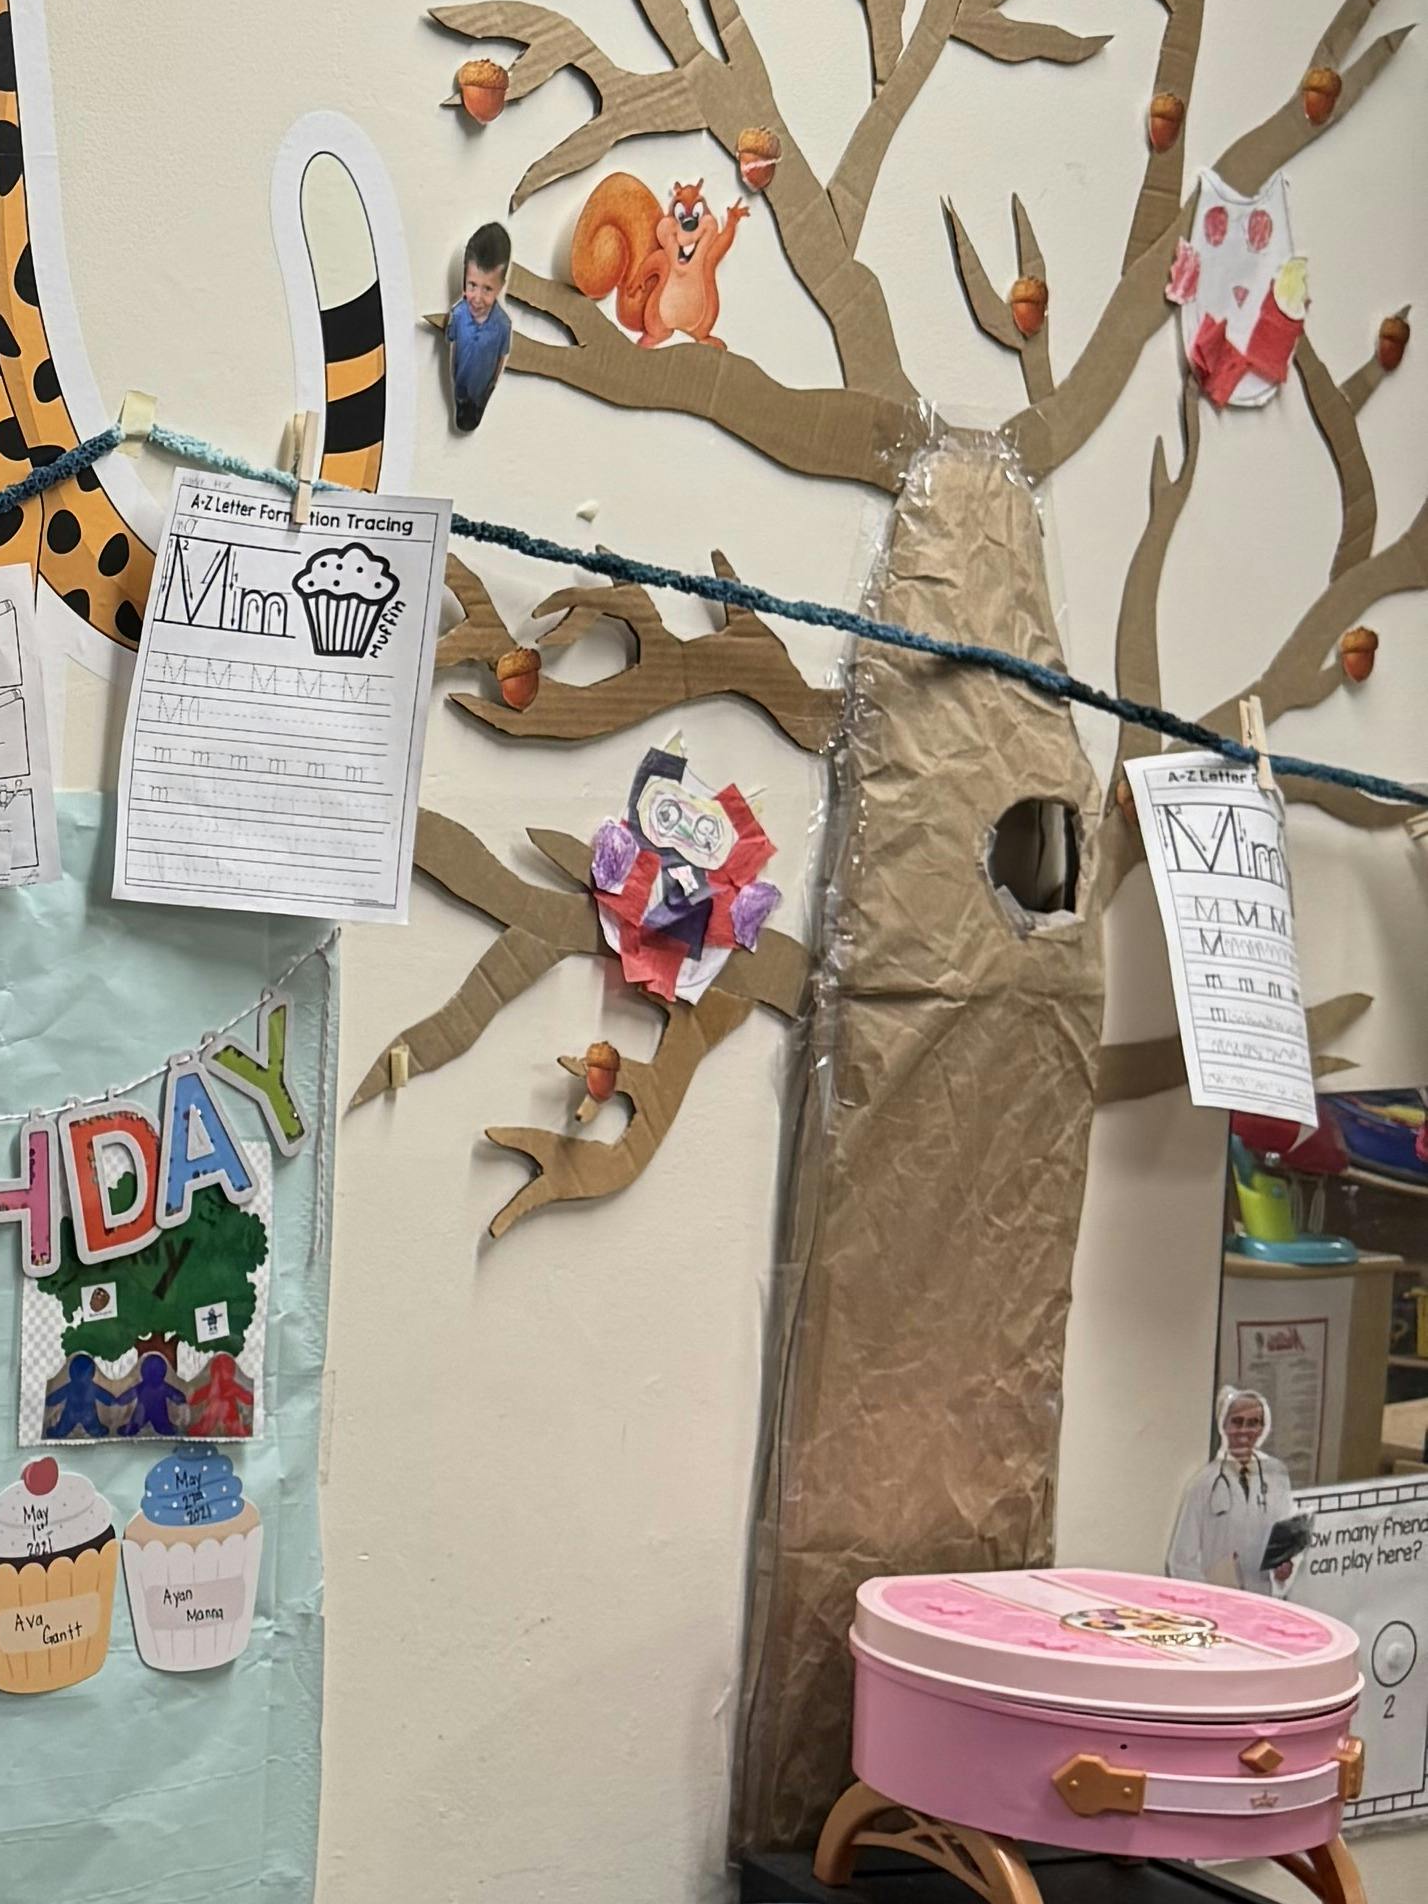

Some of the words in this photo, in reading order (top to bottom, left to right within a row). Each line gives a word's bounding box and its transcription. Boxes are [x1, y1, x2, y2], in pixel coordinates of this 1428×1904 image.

[215, 496, 256, 517] Letter
[347, 513, 414, 536] Tracing
[1200, 769, 1247, 785] Letter
[175, 1471, 202, 1491] May
[23, 1502, 49, 1525] May
[186, 1508, 212, 1526] 2021
[1308, 1530, 1332, 1549] ow
[1335, 1521, 1379, 1547] many
[27, 1537, 52, 1556] 2021
[1310, 1554, 1338, 1575] can
[1341, 1548, 1373, 1577] play
[1376, 1540, 1424, 1564] here?
[163, 1588, 193, 1608] Ayan
[14, 1613, 44, 1632] Ava
[42, 1622, 83, 1646] Gantt
[1383, 1694, 1396, 1720] 2
